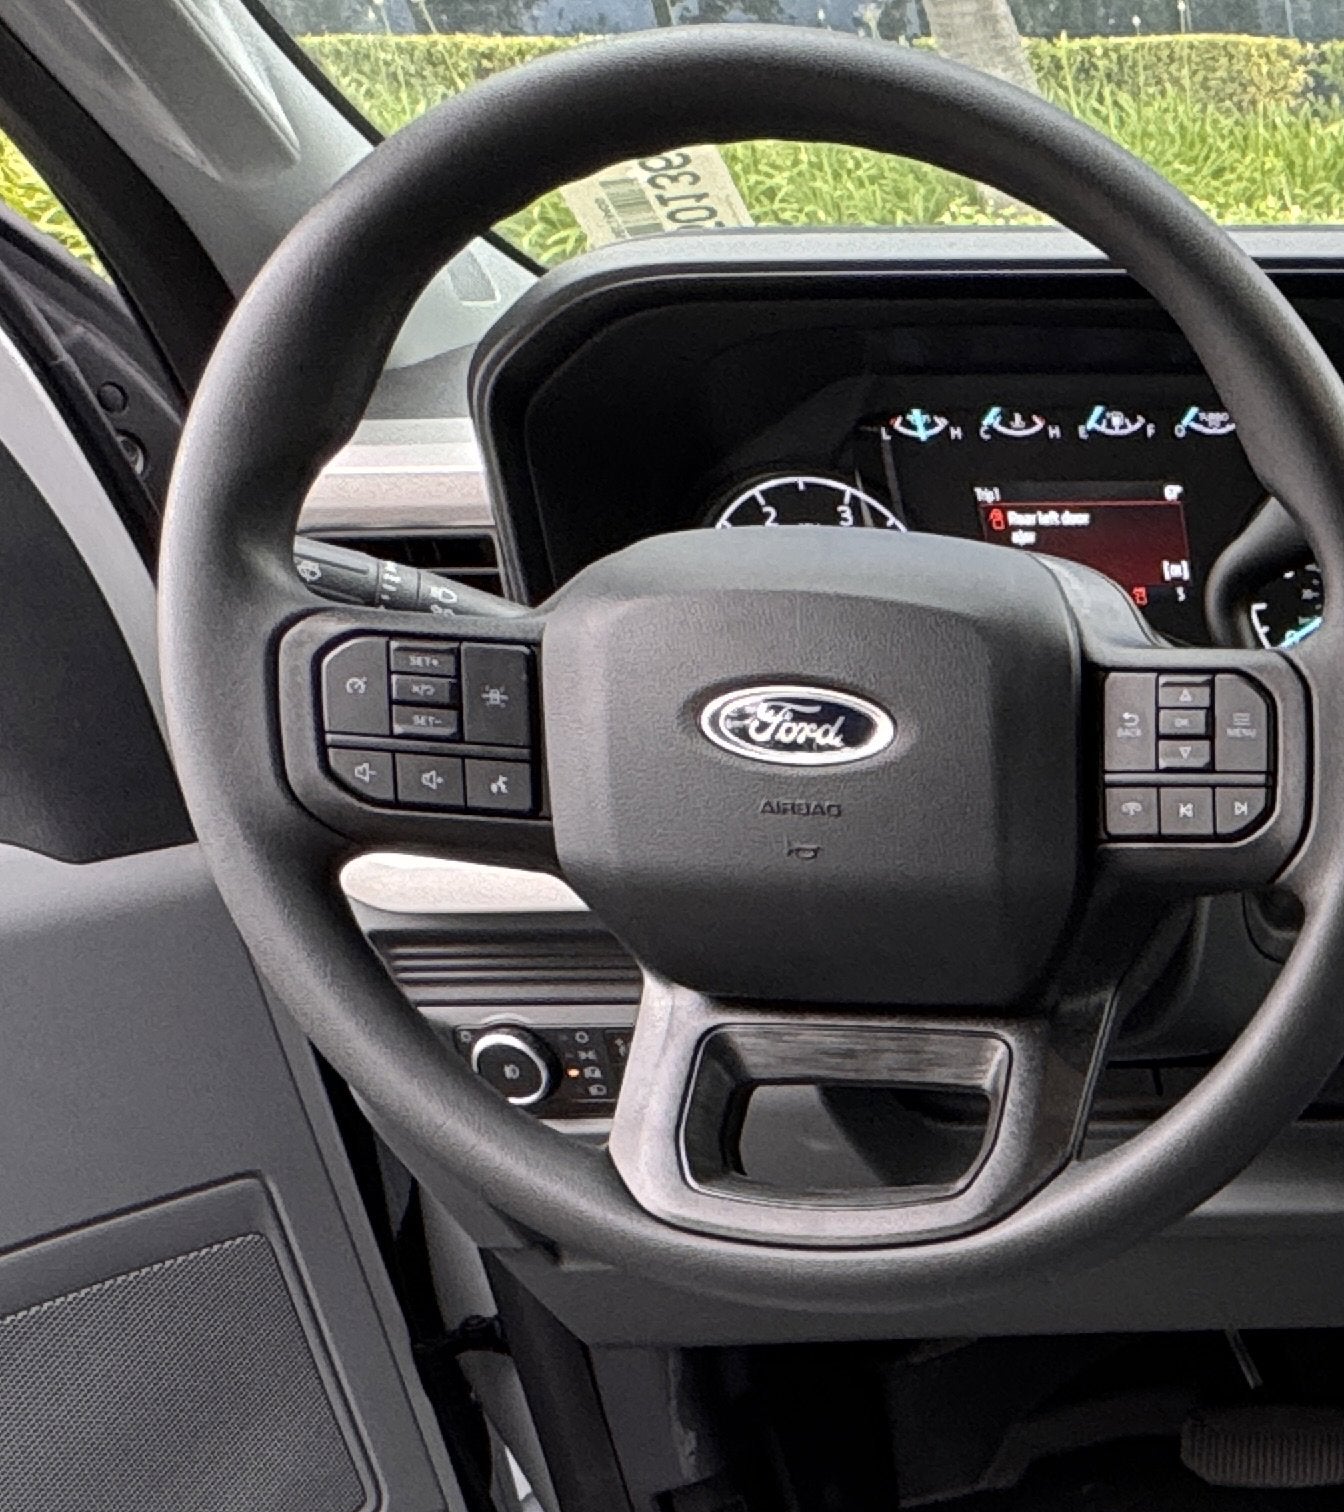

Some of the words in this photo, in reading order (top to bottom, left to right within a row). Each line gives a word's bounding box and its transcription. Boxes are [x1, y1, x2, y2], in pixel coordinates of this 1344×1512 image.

[762, 506, 779, 527] 2
[836, 505, 853, 526] 3
[744, 700, 847, 748] Ford
[760, 800, 842, 818] AIRBAG
